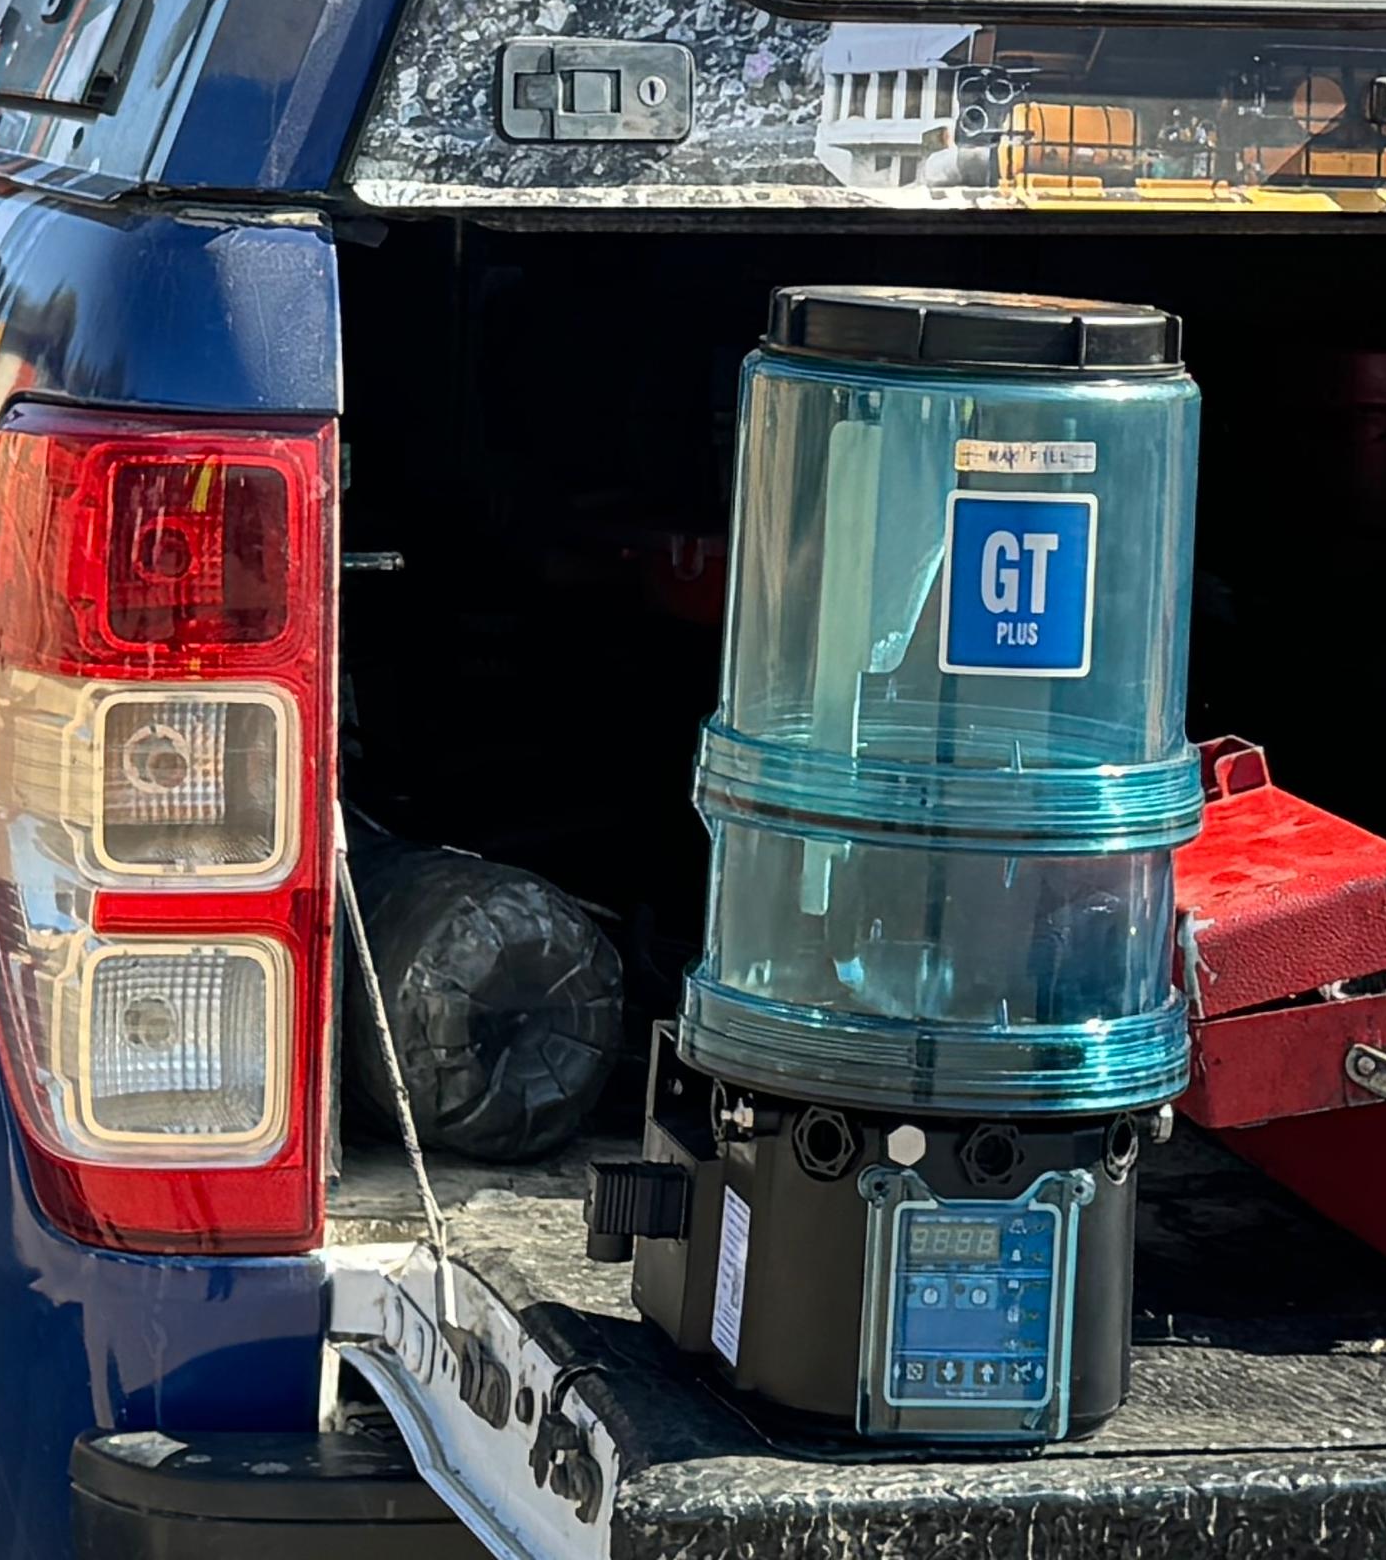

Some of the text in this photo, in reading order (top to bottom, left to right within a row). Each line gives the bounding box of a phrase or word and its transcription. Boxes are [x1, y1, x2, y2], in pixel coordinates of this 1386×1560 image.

[988, 449, 1066, 464] MAX FILL
[981, 530, 1059, 614] GT
[997, 622, 1039, 646] PLUS
